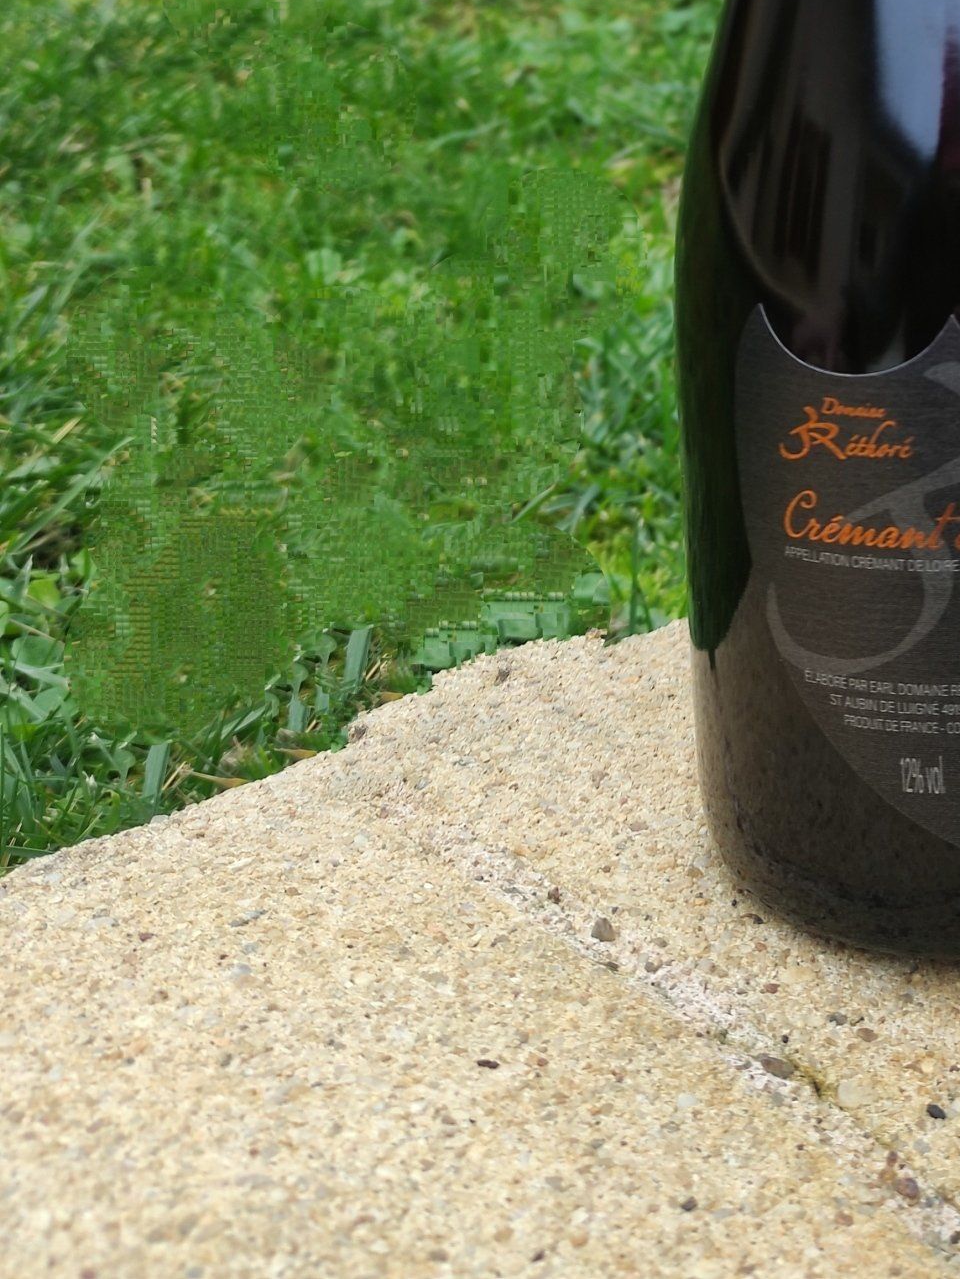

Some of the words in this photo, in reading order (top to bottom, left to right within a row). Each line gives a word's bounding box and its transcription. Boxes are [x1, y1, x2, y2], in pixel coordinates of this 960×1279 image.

[784, 546, 850, 567] APPELLATION
[852, 554, 906, 571] CRÉMANT
[908, 558, 925, 572] DE
[925, 558, 960, 572] LOIRE
[848, 678, 868, 692] PAR
[869, 680, 896, 695] EARL
[898, 683, 949, 697] DOMAINE
[829, 693, 843, 707] ST
[845, 696, 878, 712] AUBIN
[879, 700, 896, 714] DE
[885, 719, 900, 732] DE
[900, 720, 940, 734] FRANCE
[900, 757, 925, 794] 12%
